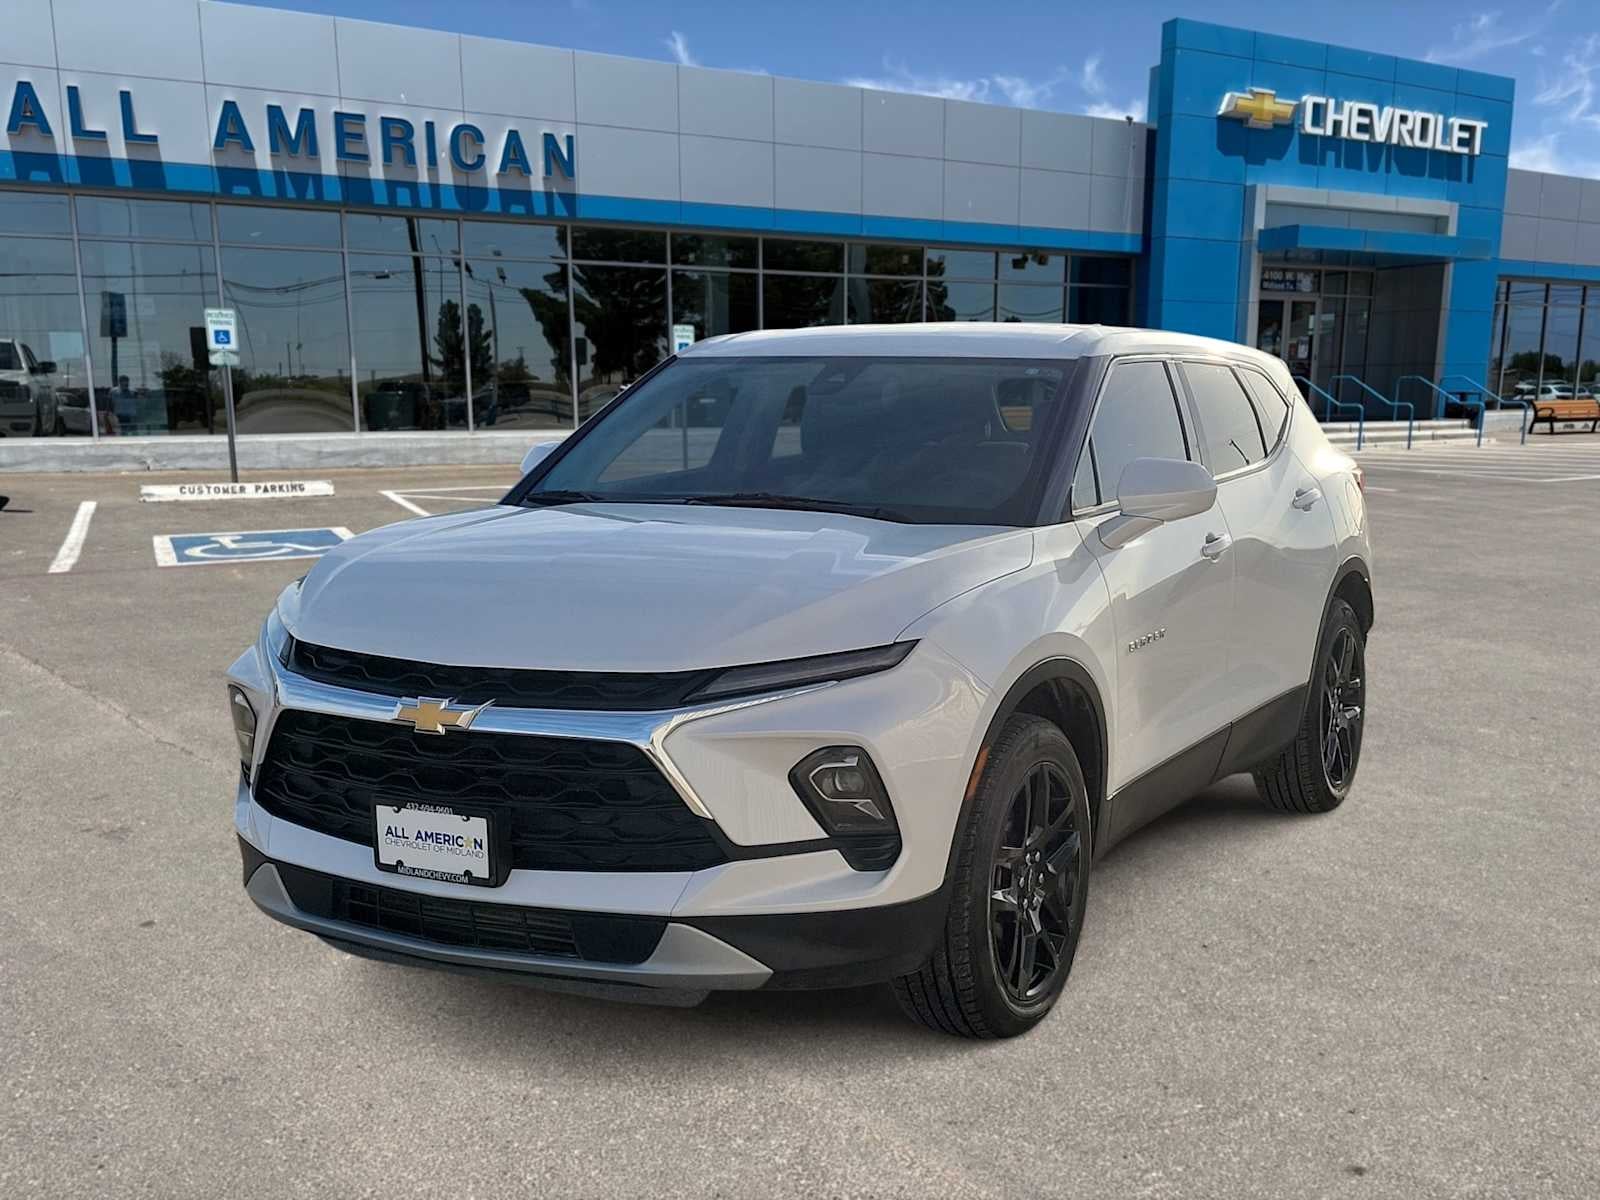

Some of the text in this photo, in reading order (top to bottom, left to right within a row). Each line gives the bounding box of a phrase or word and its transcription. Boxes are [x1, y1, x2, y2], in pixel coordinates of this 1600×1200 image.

[6, 80, 577, 179] ALL AMERICAN
[1301, 94, 1488, 155] CHEVROLET
[179, 483, 306, 495] CUSTOMER PARKING
[385, 825, 409, 840] ALL
[384, 837, 484, 860] CHEVROLET OF MIDLAND
[397, 866, 469, 884] MIDLANDCHEVY.COM
